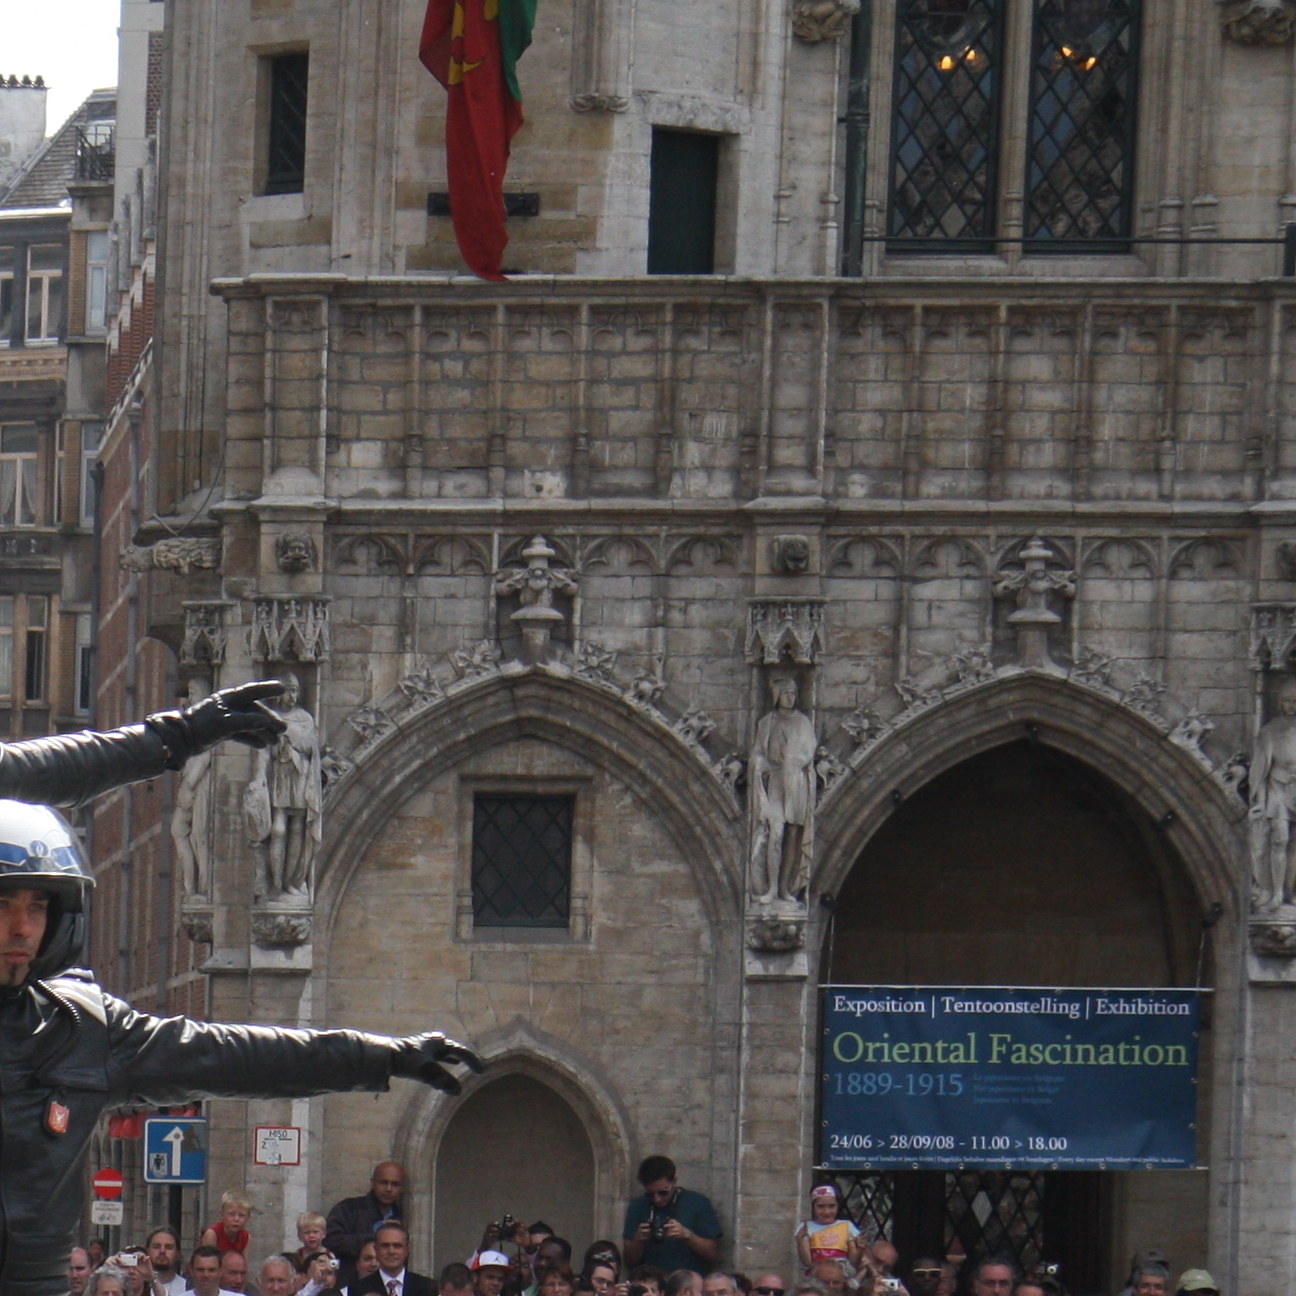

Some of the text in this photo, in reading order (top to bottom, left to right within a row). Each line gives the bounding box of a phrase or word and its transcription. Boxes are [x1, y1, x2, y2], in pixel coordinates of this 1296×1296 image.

[833, 995, 926, 1016] Exposition
[941, 997, 1080, 1019] Tentoonstelling
[1095, 998, 1190, 1016] Exhibition
[833, 1031, 1190, 1066] Oriental Fascination
[833, 1071, 964, 1096] 1889-1915
[830, 1134, 872, 1150] 24/06
[889, 1134, 955, 1150] 28/09/08
[971, 1135, 1010, 1150] 11.00
[1027, 1136, 1068, 1151] 18.00
